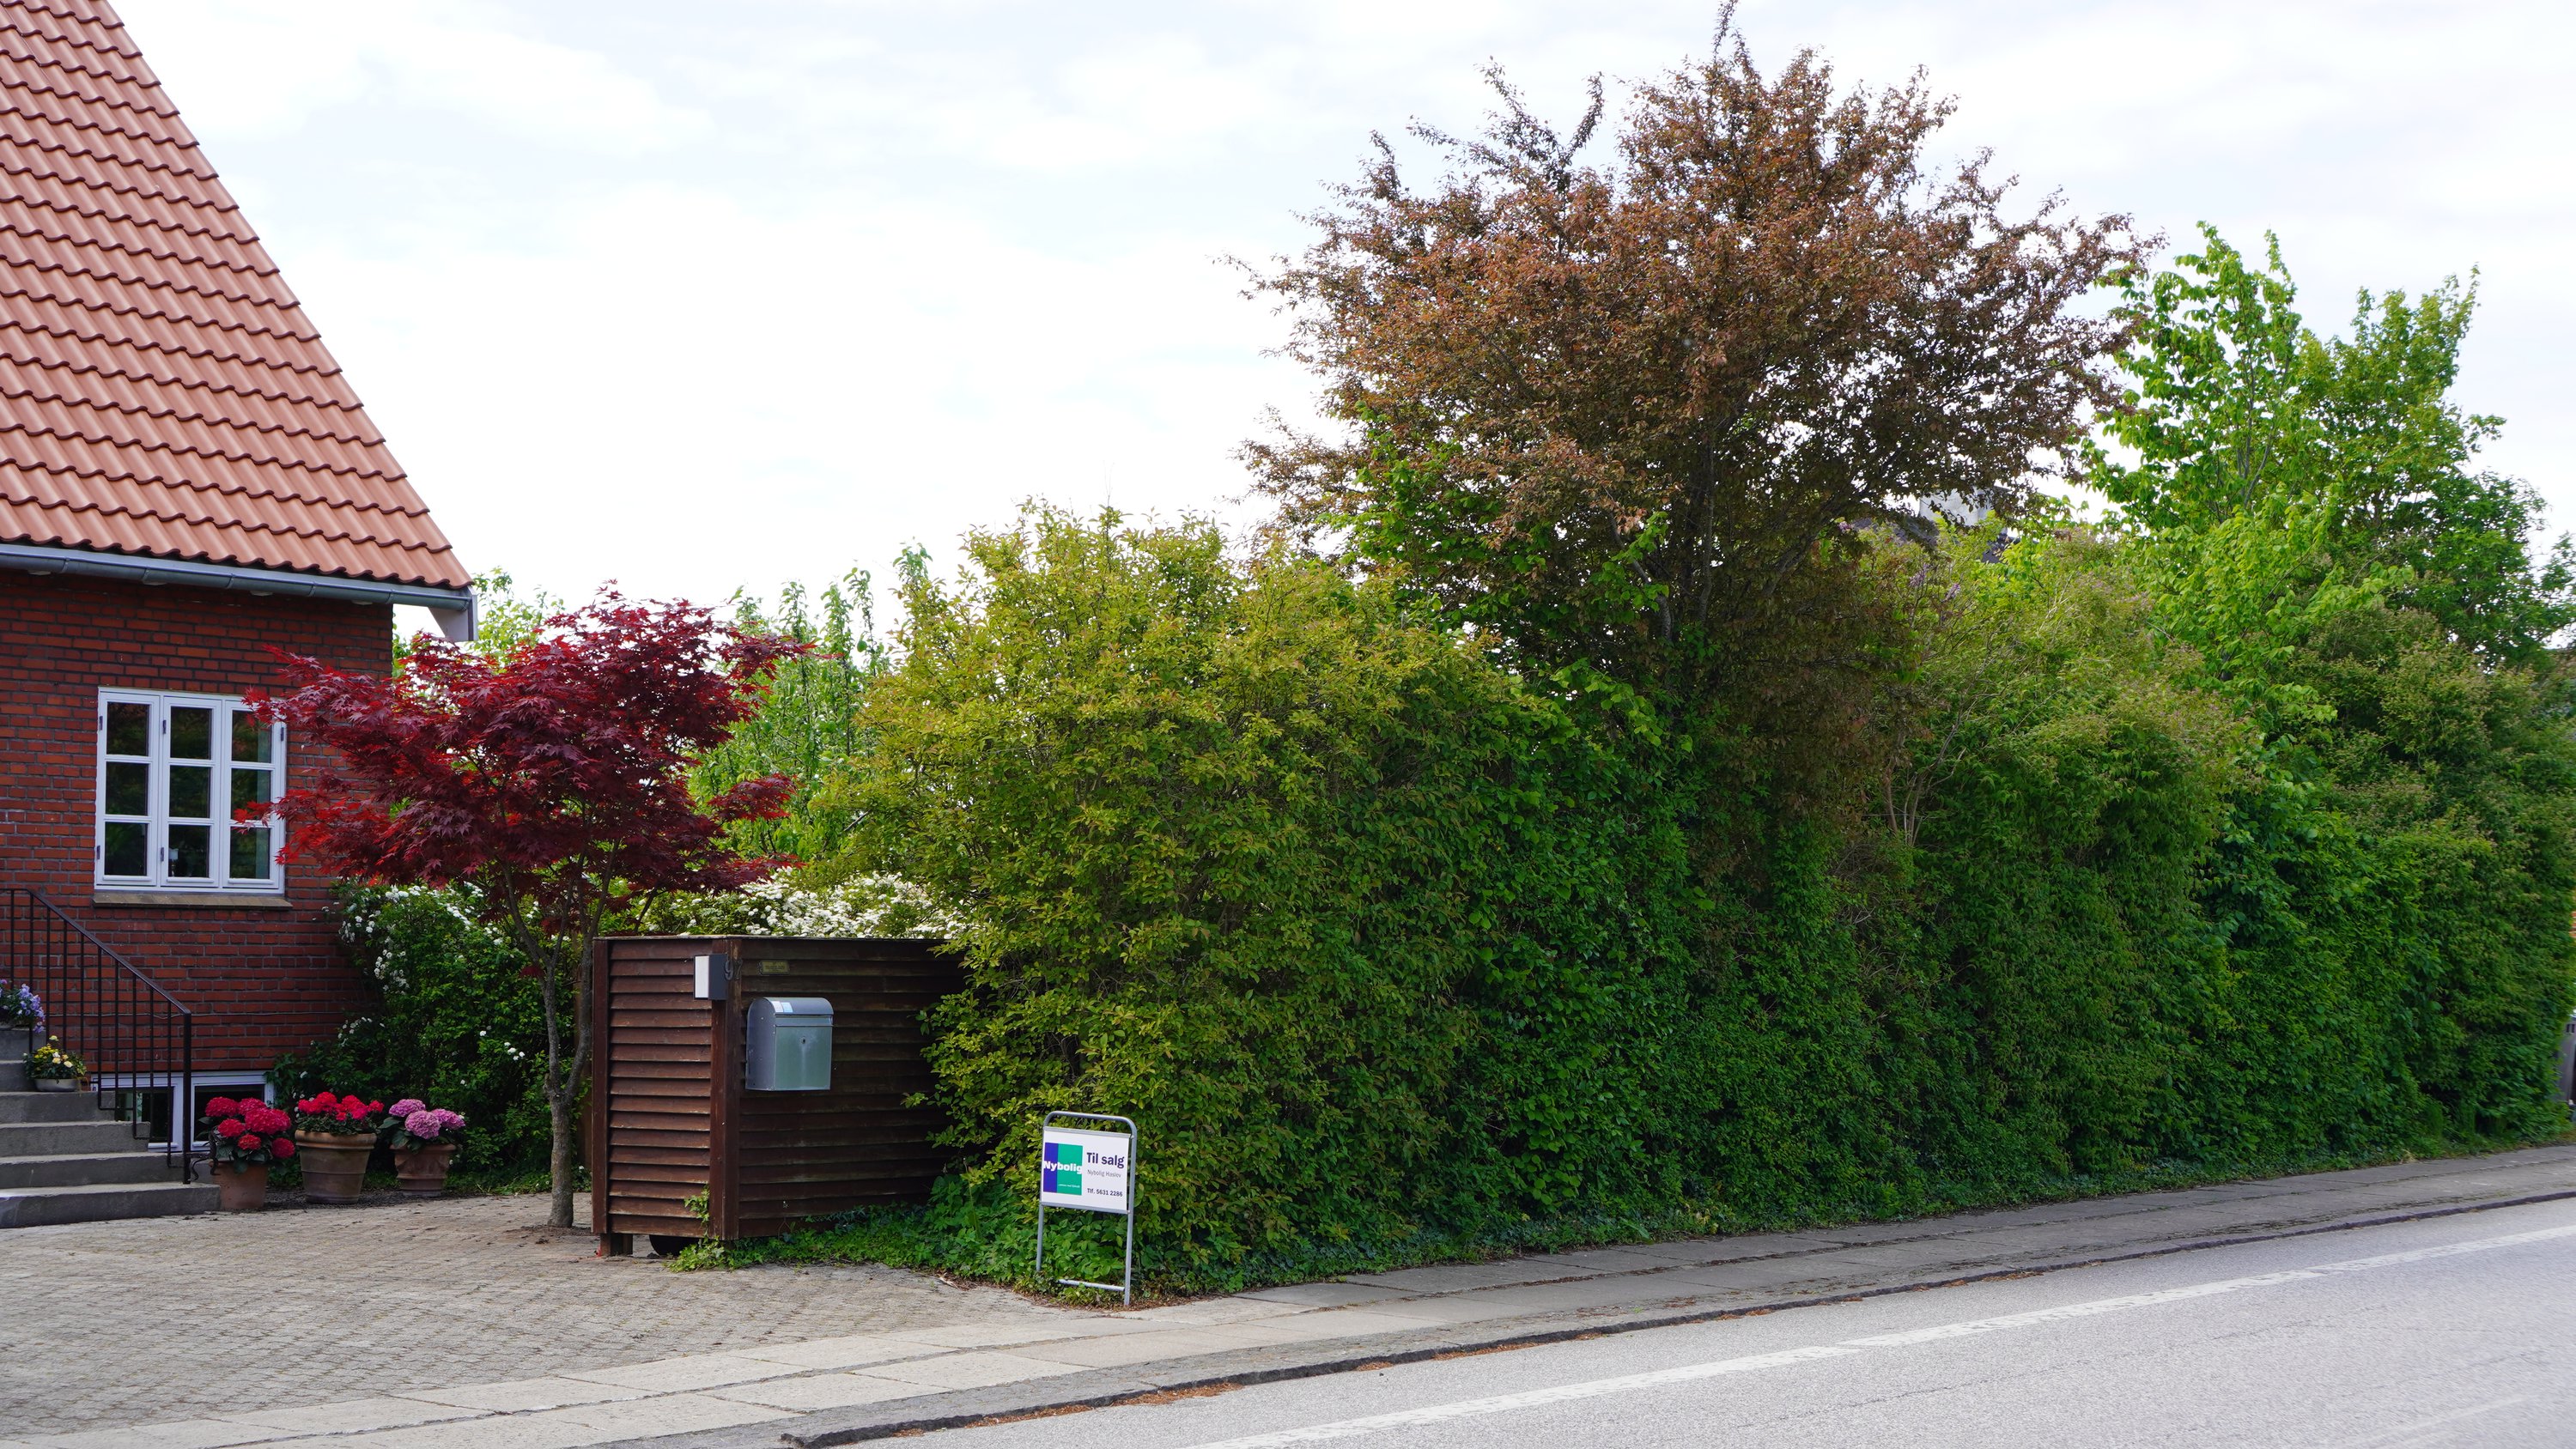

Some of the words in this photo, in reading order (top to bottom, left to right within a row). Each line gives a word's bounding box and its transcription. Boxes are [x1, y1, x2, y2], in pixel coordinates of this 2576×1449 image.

[1043, 1160, 1083, 1175] Nybolig
[1086, 1152, 1099, 1164] Til
[1101, 1155, 1125, 1169] salg
